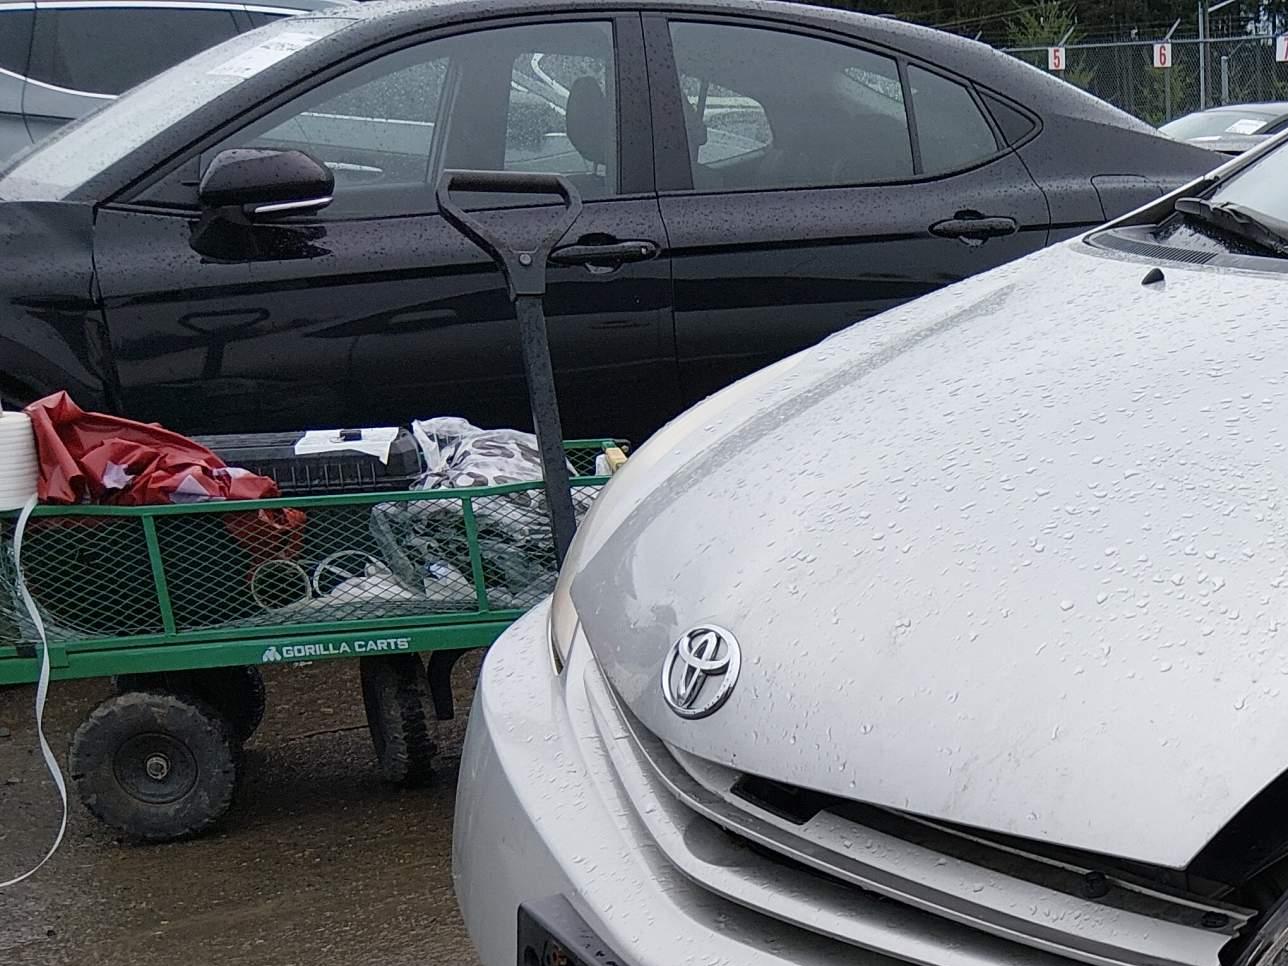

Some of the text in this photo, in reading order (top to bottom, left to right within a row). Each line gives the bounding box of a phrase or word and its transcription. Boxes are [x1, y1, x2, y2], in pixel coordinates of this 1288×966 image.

[1053, 48, 1061, 68] 5
[1159, 45, 1167, 66] 6
[282, 637, 409, 658] GORILLA CARTS
